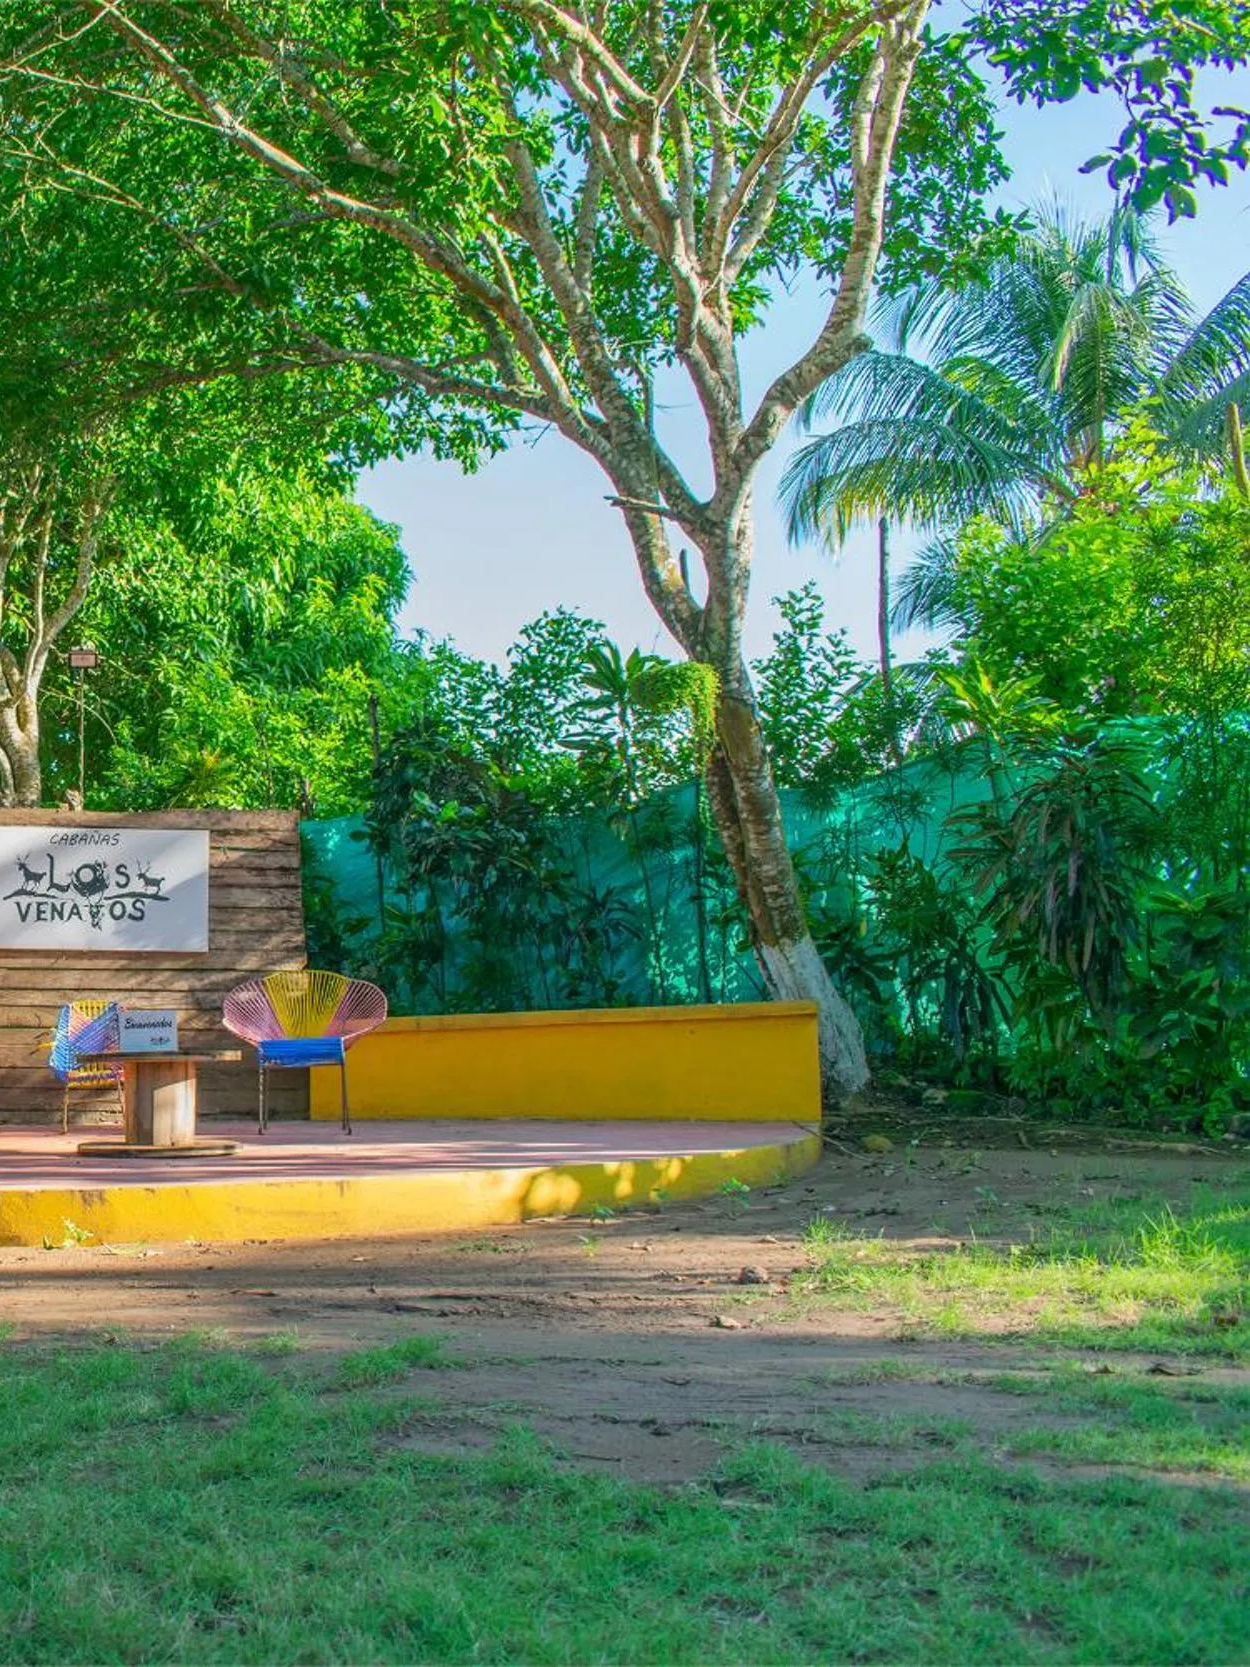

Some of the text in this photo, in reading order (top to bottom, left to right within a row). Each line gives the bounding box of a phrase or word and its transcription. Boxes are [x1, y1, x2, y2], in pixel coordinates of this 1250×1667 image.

[49, 830, 121, 847] CABAÑAS
[46, 853, 131, 895] LOS
[15, 900, 146, 925] VENAOS
